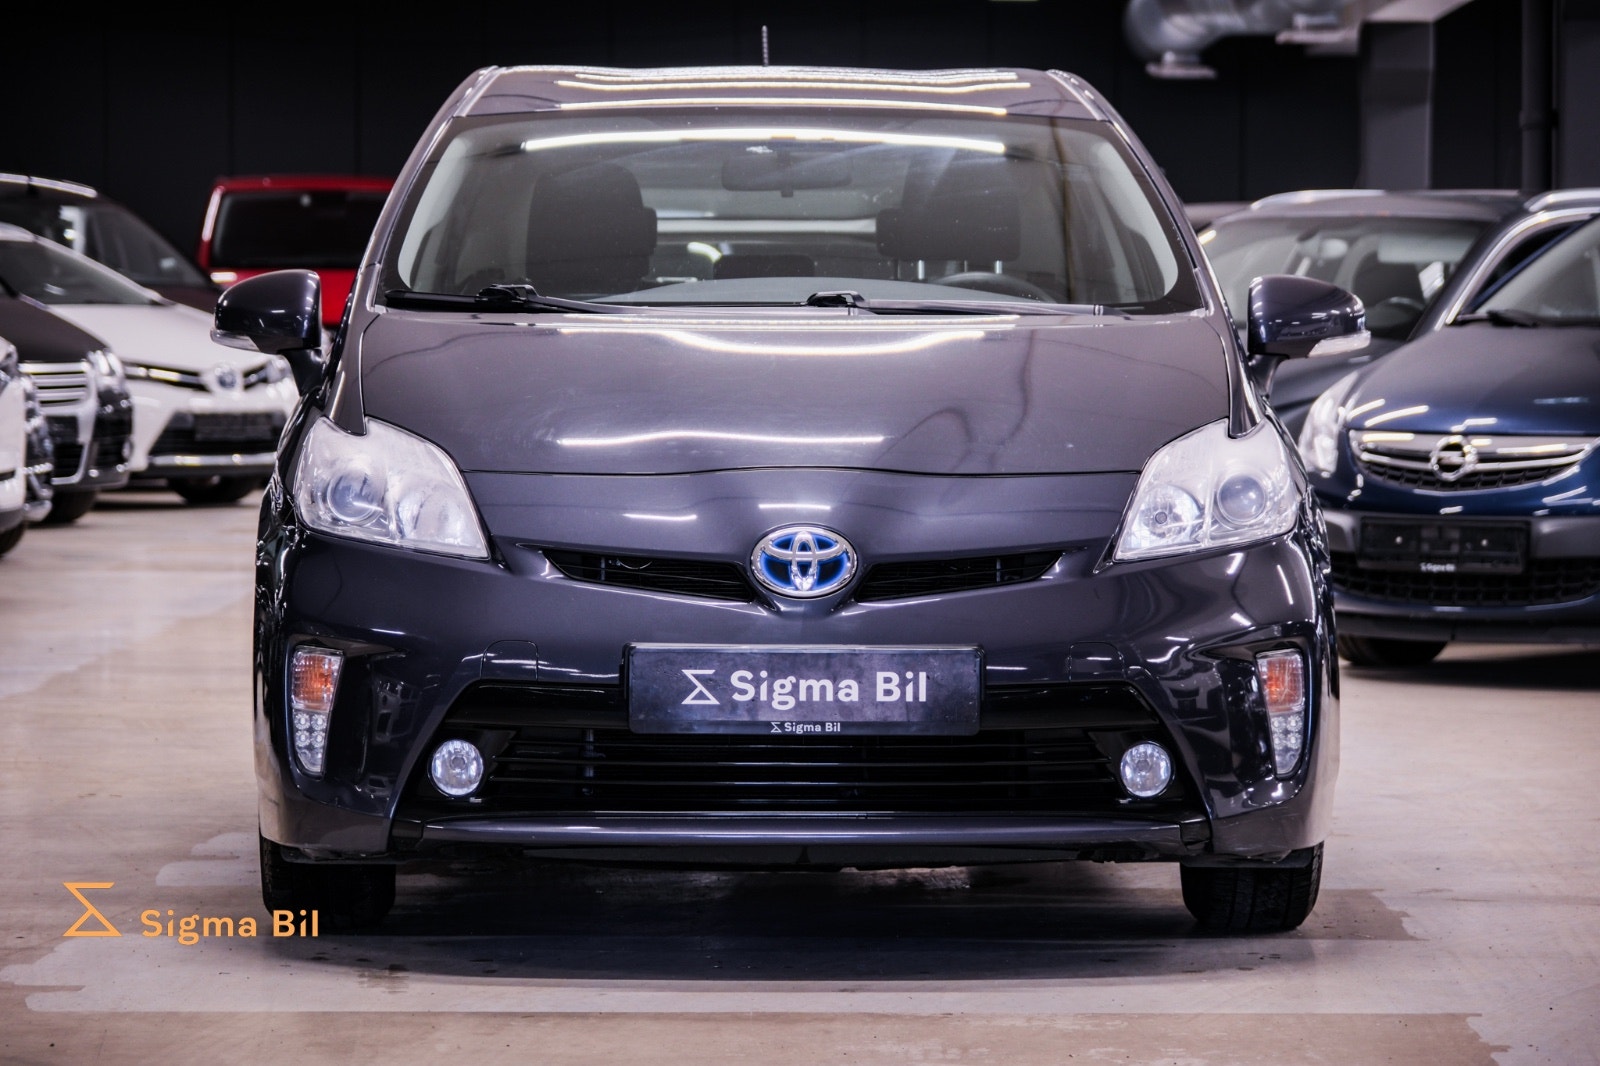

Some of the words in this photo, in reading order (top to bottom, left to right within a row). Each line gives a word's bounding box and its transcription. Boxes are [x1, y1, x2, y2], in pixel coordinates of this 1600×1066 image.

[730, 670, 859, 711] Sigma
[875, 671, 927, 702] Bil
[784, 722, 822, 735] Sigma
[825, 722, 841, 732] Bil
